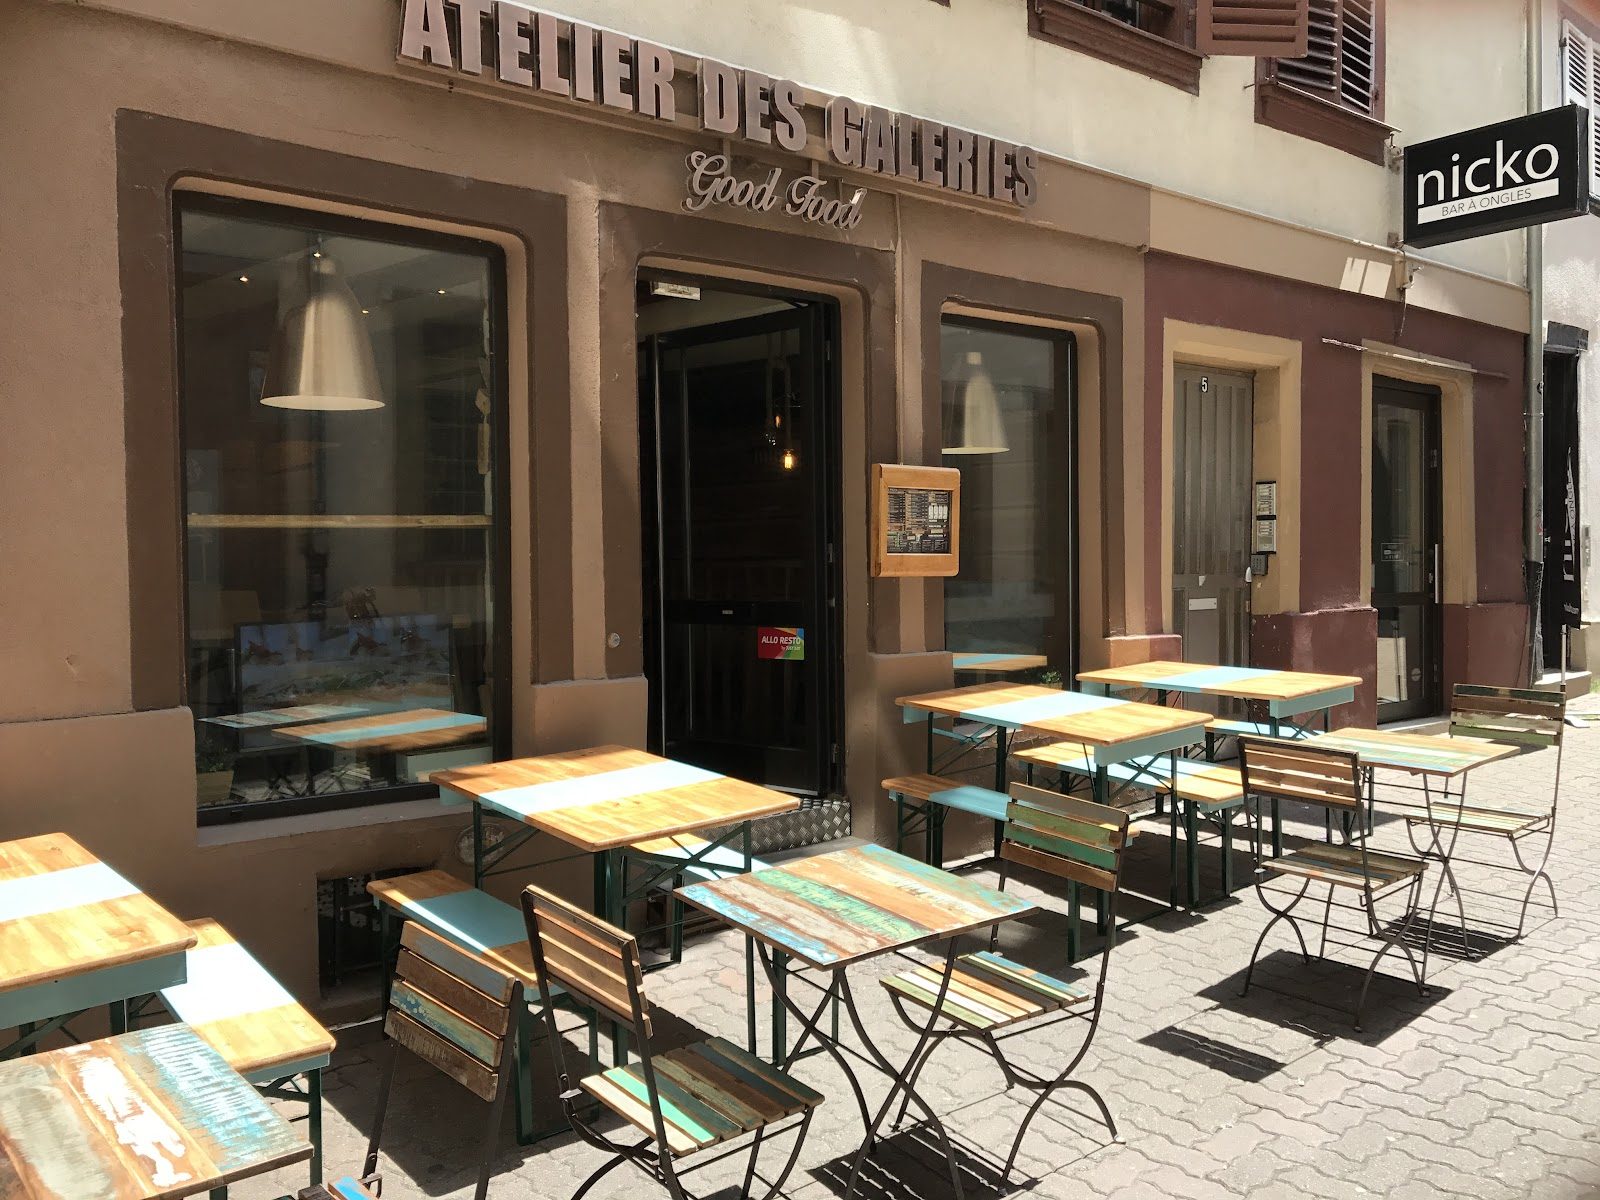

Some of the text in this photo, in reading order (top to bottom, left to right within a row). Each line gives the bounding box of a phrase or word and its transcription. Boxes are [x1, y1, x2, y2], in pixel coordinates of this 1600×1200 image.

[400, 0, 1038, 207] ATELIER DES GALERIES
[684, 151, 868, 230] Good Food
[1417, 140, 1559, 206] nicko
[1441, 202, 1465, 217] BAR
[1480, 187, 1532, 208] ONGLES
[1201, 376, 1208, 393] 5
[761, 635, 801, 645] ALLO RESTO
